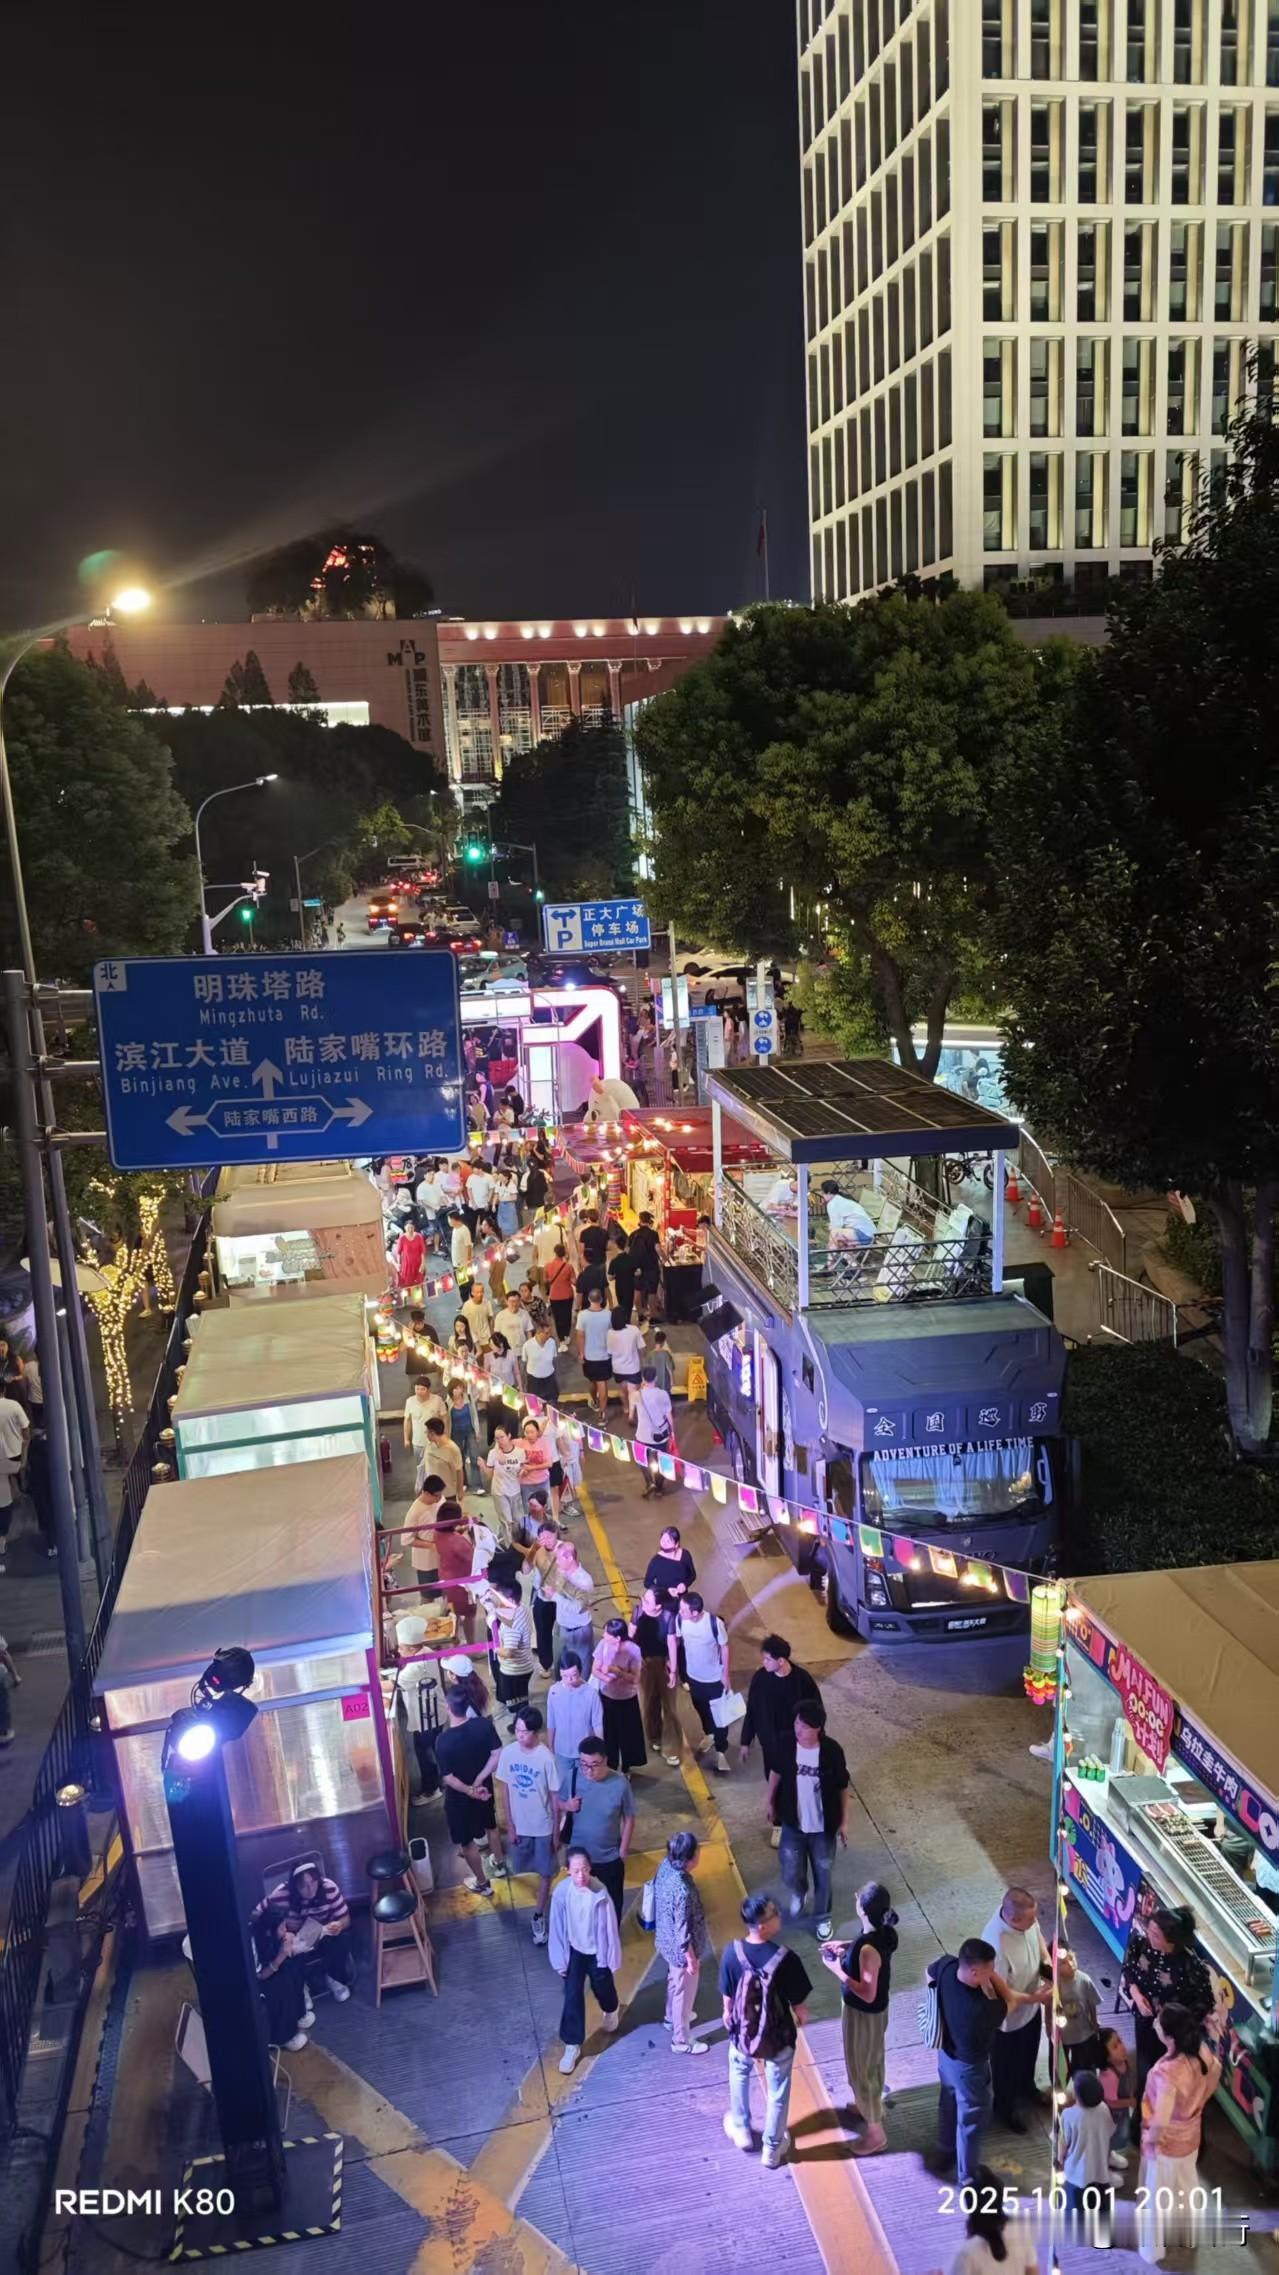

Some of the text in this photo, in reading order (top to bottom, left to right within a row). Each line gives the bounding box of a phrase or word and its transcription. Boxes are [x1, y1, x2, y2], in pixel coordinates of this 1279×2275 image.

[387, 640, 425, 665] MAP
[583, 904, 644, 921] 正大广场
[557, 930, 573, 949] P
[592, 920, 639, 937] 停车场
[101, 963, 118, 980] 北
[194, 969, 325, 1003] 明珠塔路
[200, 1004, 324, 1027] Mingzhuta Rd.
[115, 1037, 250, 1072] 滨江大道
[285, 1029, 447, 1065] 陆家嘴环路
[121, 1074, 248, 1096] Binjiang Ave.
[290, 1063, 448, 1088] Lujiazui Ring Rd.
[224, 1106, 318, 1127] 陆家嘴西路
[873, 1436, 1034, 1462] ADVENTURE OF A LIFE TIME
[346, 1702, 369, 1713] A02
[509, 1763, 540, 1778] ADIDAS
[1181, 1727, 1238, 1799] 乌拉圭牛肉
